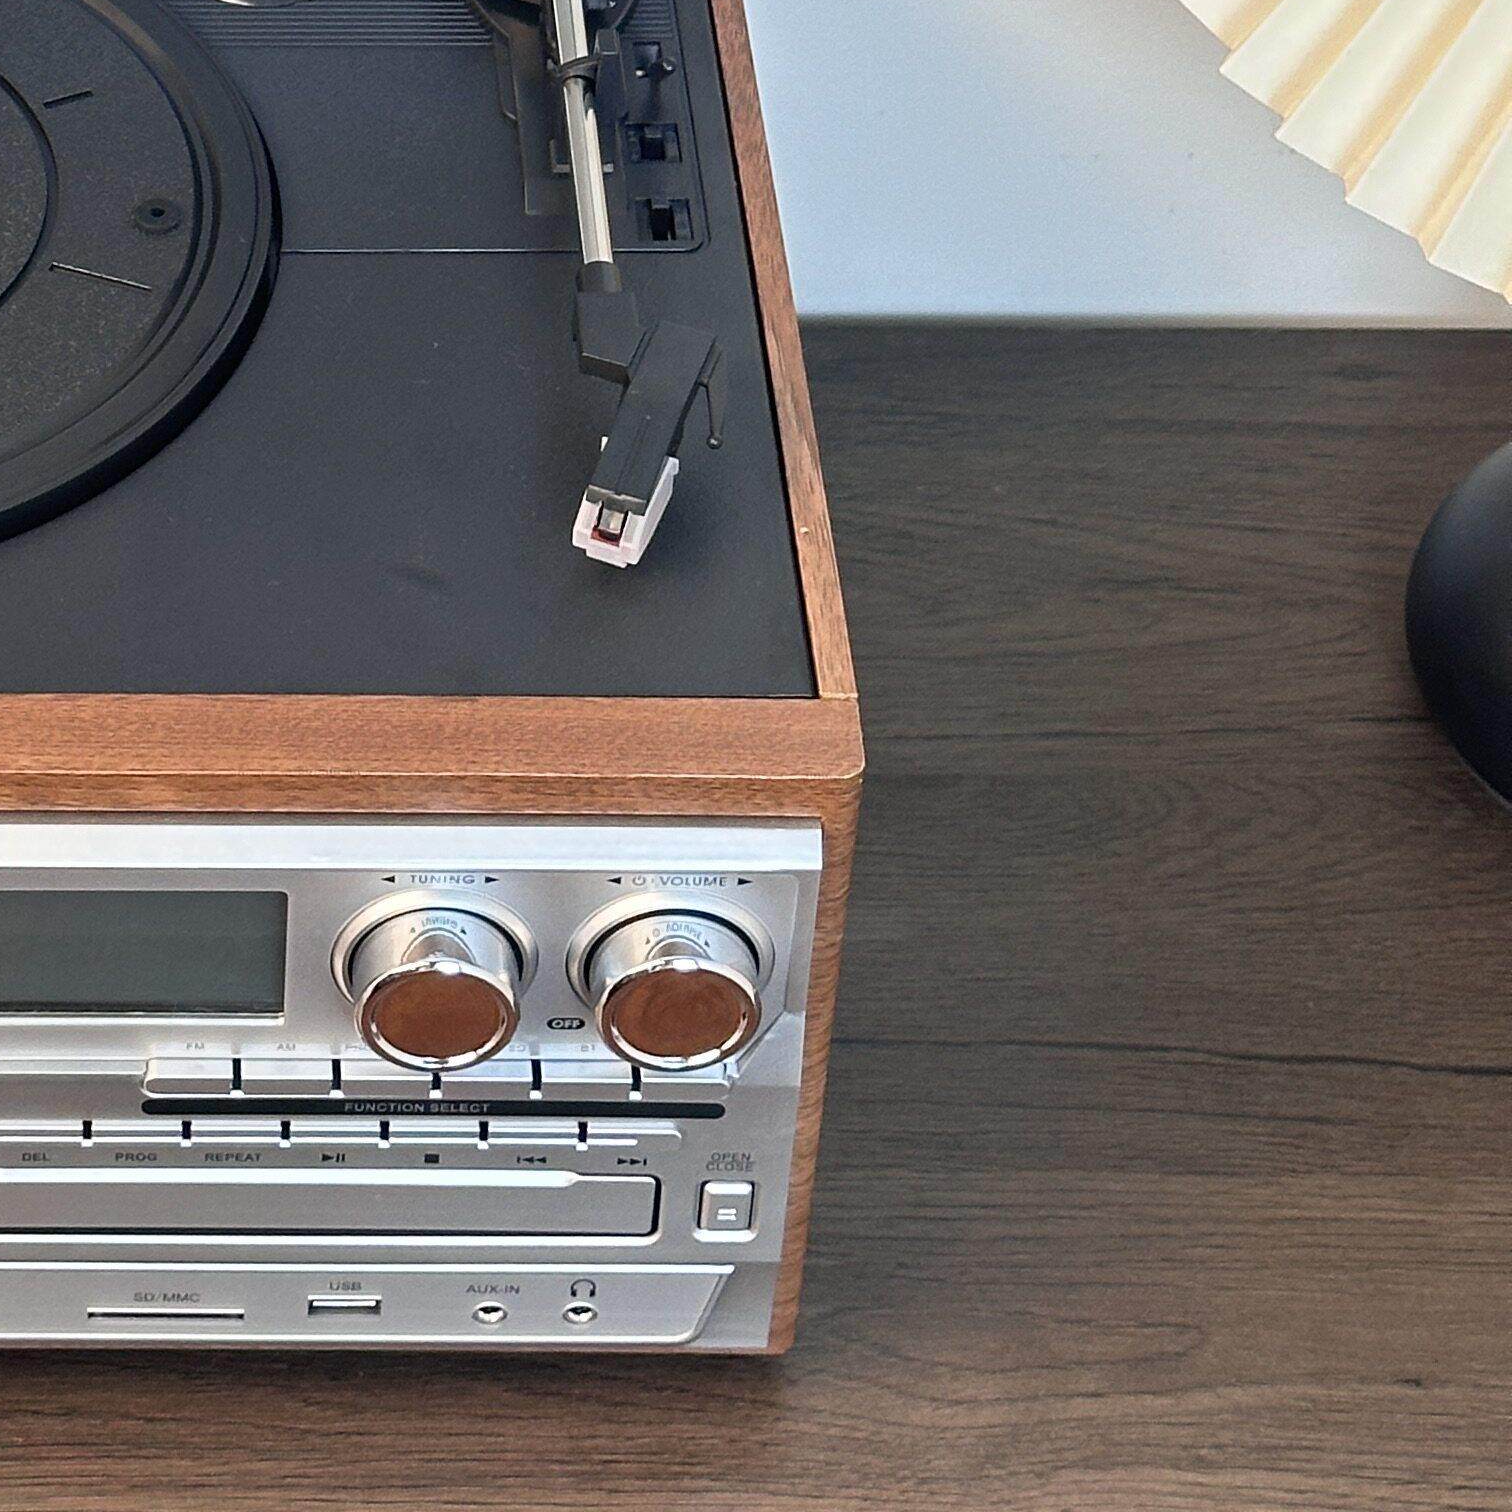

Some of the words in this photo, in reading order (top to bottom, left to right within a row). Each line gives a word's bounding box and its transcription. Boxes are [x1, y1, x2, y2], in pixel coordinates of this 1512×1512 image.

[409, 874, 476, 885] TUNING
[658, 875, 729, 887] VOLUME
[551, 1019, 580, 1029] OFF
[344, 1102, 425, 1113] FUNCTION
[429, 1103, 489, 1114] SELECT
[21, 1152, 51, 1162] DEL
[114, 1152, 158, 1162] PROG
[204, 1152, 263, 1163] REPEAT
[710, 1152, 752, 1161] OPEN
[705, 1161, 755, 1172] CLOSE
[329, 1279, 362, 1291] USB
[133, 1292, 201, 1303] SD/MMC
